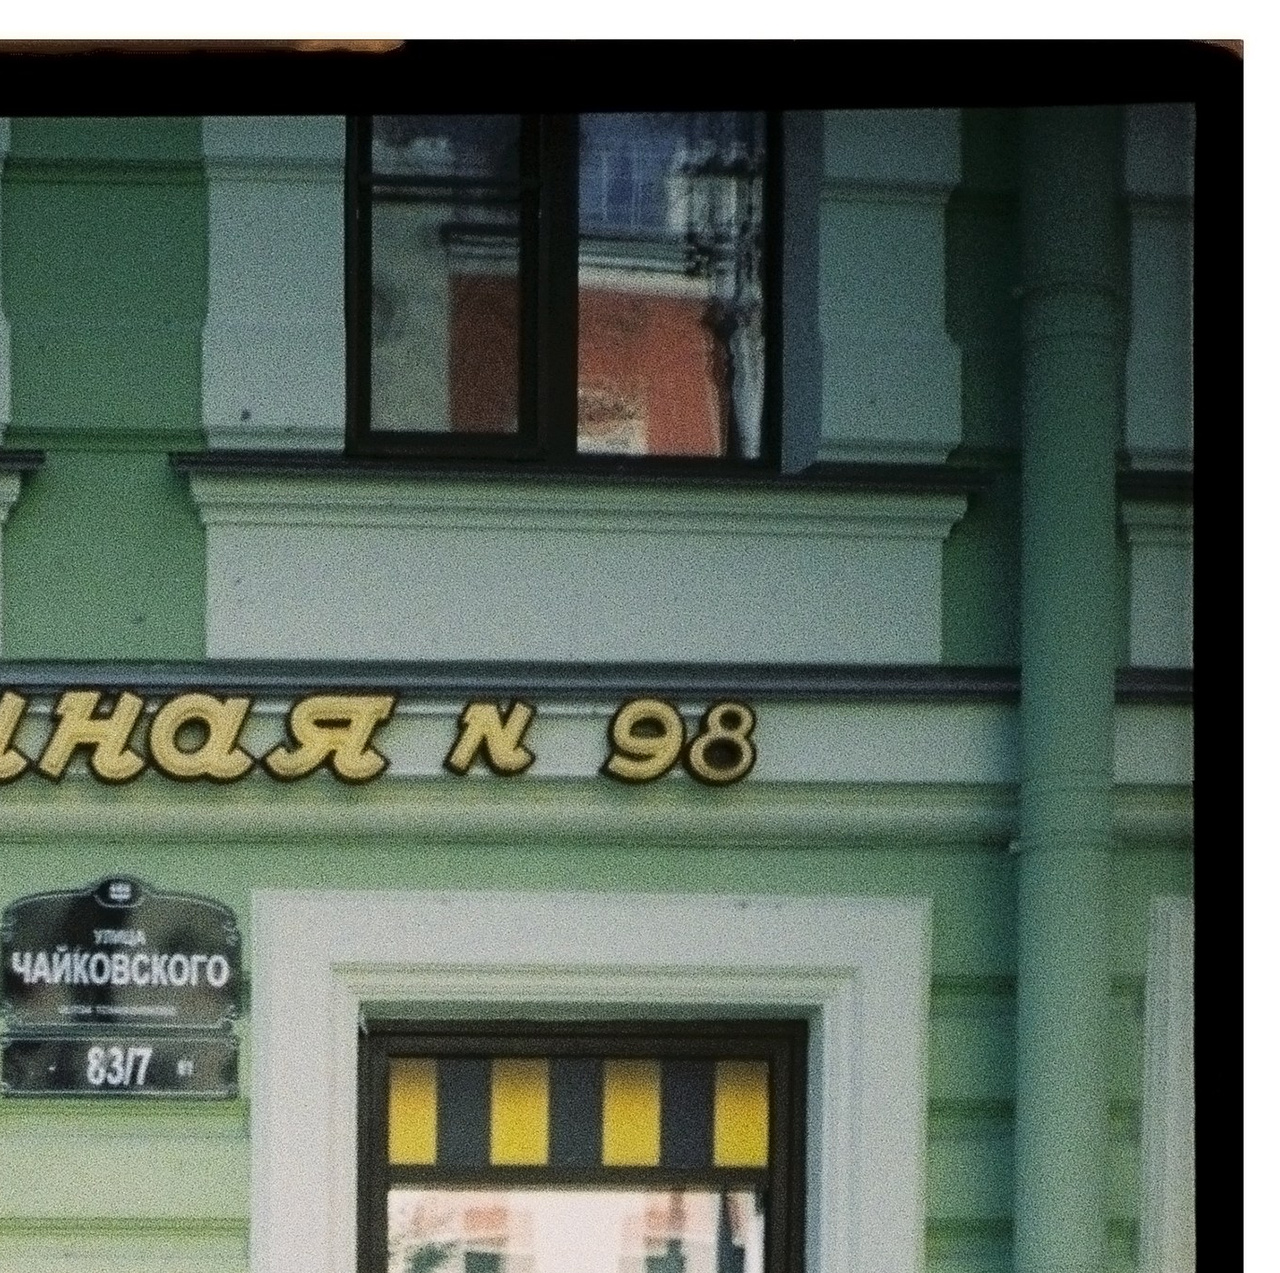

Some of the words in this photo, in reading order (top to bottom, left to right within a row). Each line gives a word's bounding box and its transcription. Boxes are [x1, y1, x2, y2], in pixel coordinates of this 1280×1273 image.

[600, 696, 756, 785] 98
[93, 929, 146, 946] УЛИЦА
[11, 945, 230, 987] ЧАЙКОВСКОГО
[86, 1046, 153, 1085] 83/7
